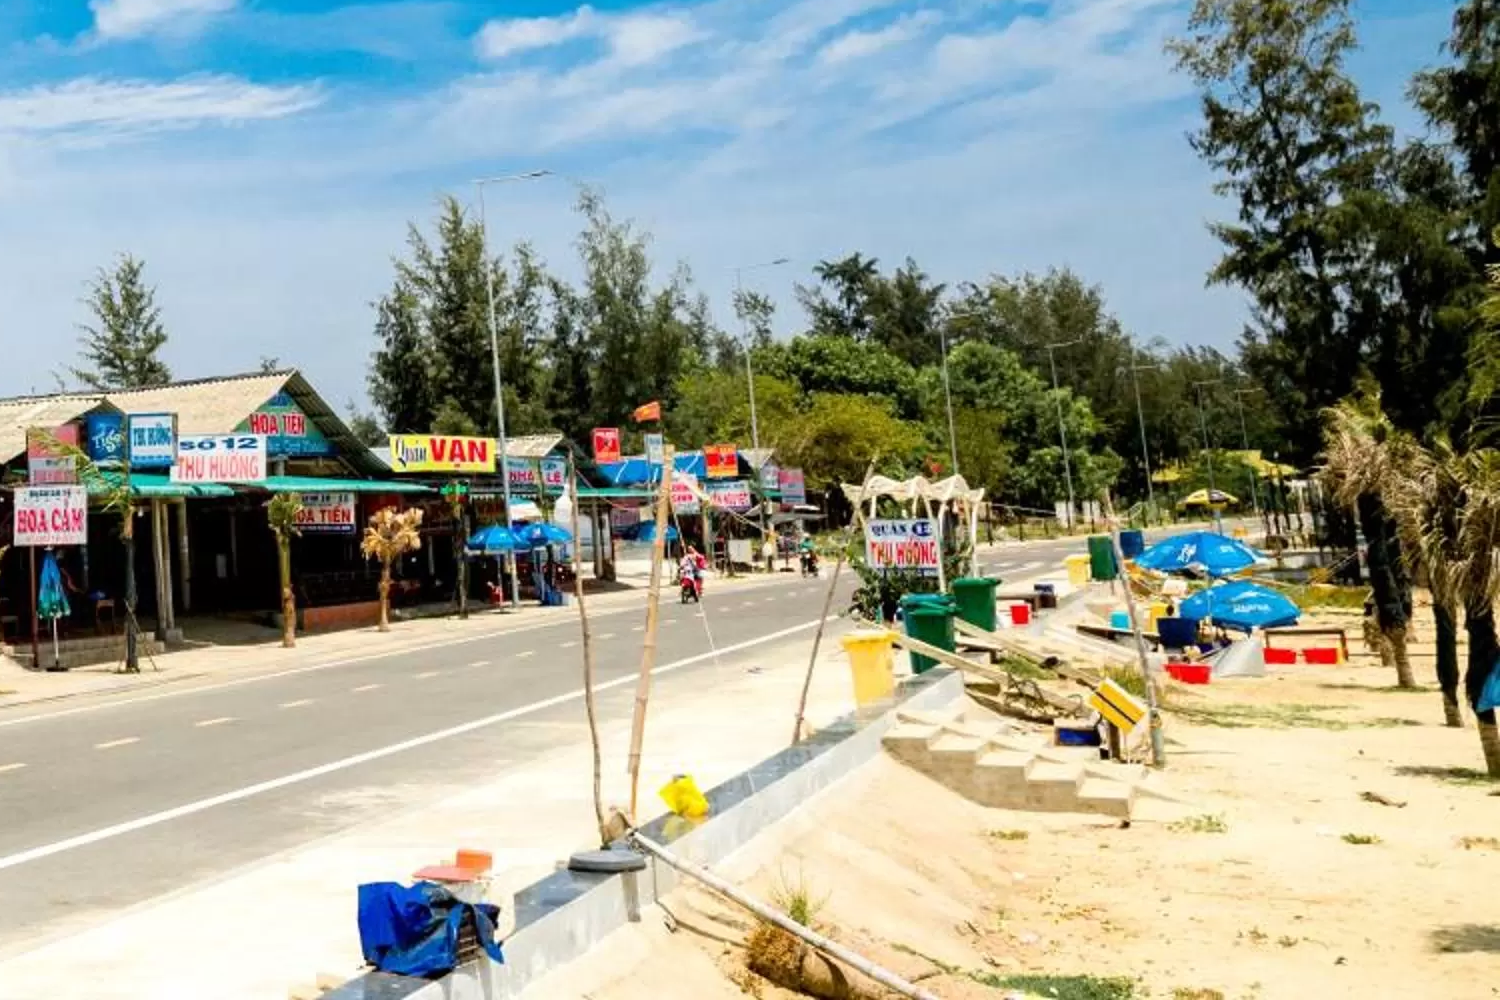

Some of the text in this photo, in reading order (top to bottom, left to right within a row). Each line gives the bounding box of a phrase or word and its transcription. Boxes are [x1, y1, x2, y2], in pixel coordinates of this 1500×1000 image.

[250, 414, 278, 434] HOA
[222, 437, 258, 449] 12
[178, 456, 204, 479] THU
[18, 509, 48, 533] HOA
[295, 509, 314, 522] OA
[871, 542, 892, 565] THU
